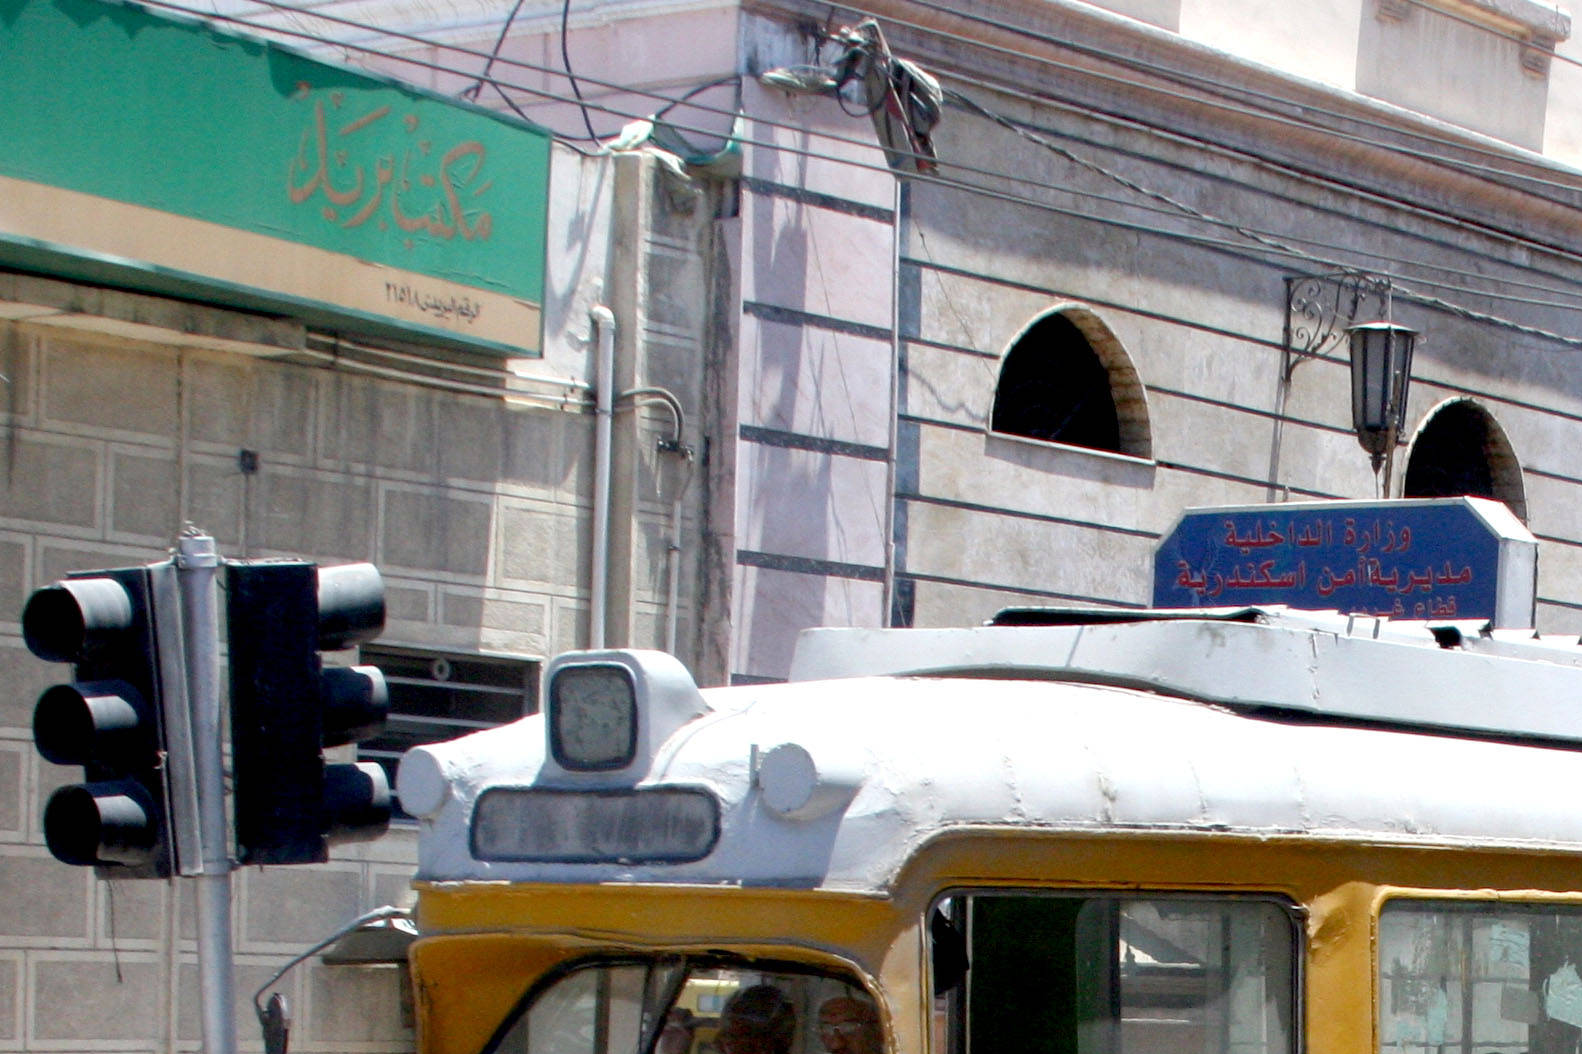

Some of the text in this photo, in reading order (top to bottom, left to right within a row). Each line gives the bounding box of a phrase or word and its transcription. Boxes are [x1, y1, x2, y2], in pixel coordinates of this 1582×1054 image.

[1223, 517, 1412, 555] وزارة الداخلية
[1176, 560, 1306, 597] اسكندرية
[1368, 556, 1473, 594] مديرية
